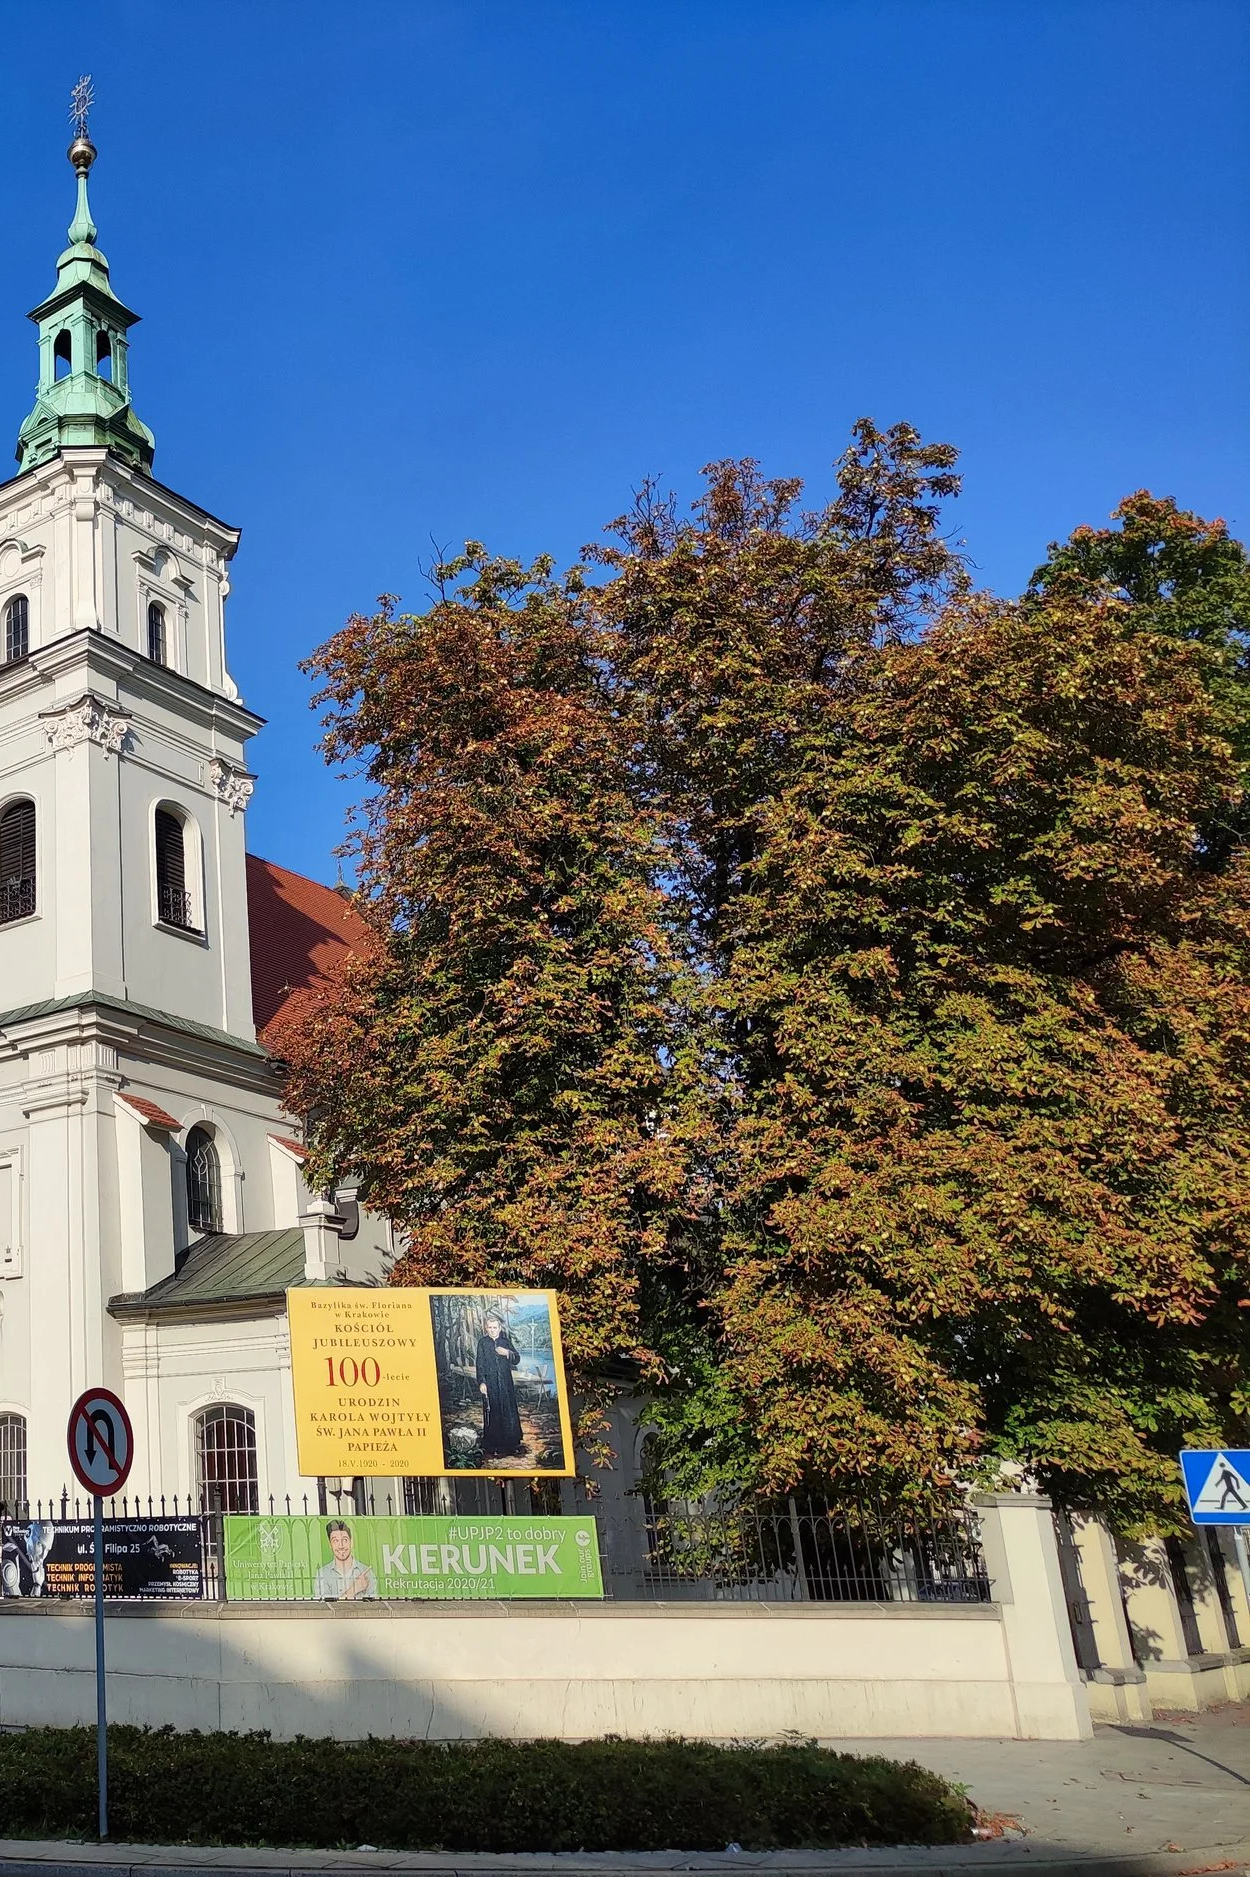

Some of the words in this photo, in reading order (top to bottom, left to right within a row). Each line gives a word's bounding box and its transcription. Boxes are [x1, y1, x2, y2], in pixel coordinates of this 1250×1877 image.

[311, 1301, 352, 1311] Bazylika
[335, 1322, 394, 1333] KOŚCIÓŁ
[312, 1338, 417, 1350] JUBILEUSZOWY
[324, 1356, 381, 1388] 100
[338, 1398, 400, 1407] URODZIN
[310, 1412, 365, 1422] KAROLA
[369, 1412, 431, 1425] WOJTYŁY
[316, 1425, 336, 1437] ŚW.
[338, 1427, 370, 1439] JANA
[373, 1427, 414, 1437] PAWŁA
[417, 1427, 427, 1437] II
[347, 1440, 399, 1451] PAPIEŻA
[338, 1459, 378, 1468] 18.V.1920
[390, 1459, 410, 1468] 2020
[43, 1525, 80, 1534] TECHNIKUM
[81, 1524, 148, 1533] PRORAMISTYCZNO
[148, 1523, 197, 1532] ROBOTYCZNE
[449, 1526, 503, 1540] #UPJP2
[507, 1529, 522, 1540] to
[525, 1526, 566, 1543] dobry
[104, 1543, 128, 1555] Filipa
[130, 1544, 140, 1553] 25
[382, 1544, 563, 1575] KIERUNEK
[585, 1548, 594, 1577] groups
[46, 1563, 73, 1572] TECHNIK
[47, 1573, 75, 1582] TECHNIK
[78, 1573, 123, 1582] INFOATYK
[580, 1565, 588, 1583] Join
[47, 1583, 80, 1592] TECHNIK
[84, 1583, 124, 1592] ROOTYK
[385, 1577, 445, 1590] Rekrutacja
[447, 1577, 495, 1589] 2020/21
